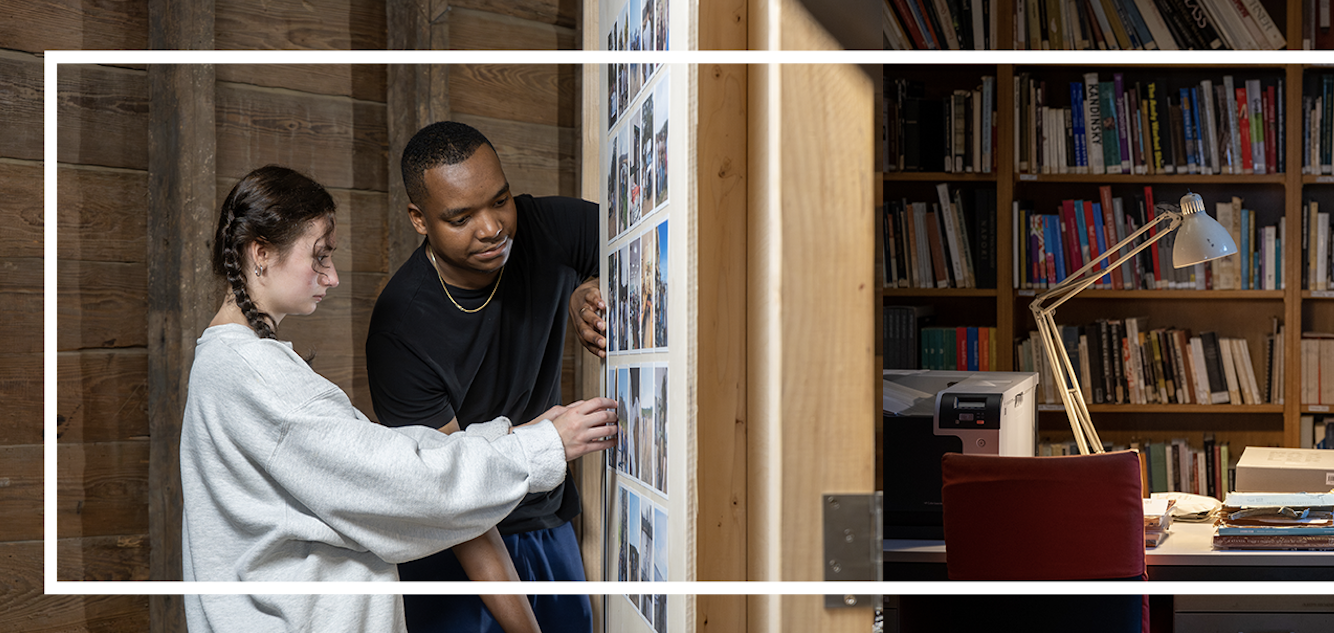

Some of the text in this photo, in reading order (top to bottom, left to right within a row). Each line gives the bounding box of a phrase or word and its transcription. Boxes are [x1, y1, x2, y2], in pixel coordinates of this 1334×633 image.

[1148, 83, 1156, 98] The
[1088, 84, 1102, 145] KANDINSKY
[1117, 97, 1127, 139] Symbolism
[1149, 99, 1158, 121] Andy
[1151, 122, 1161, 150] Warhol
